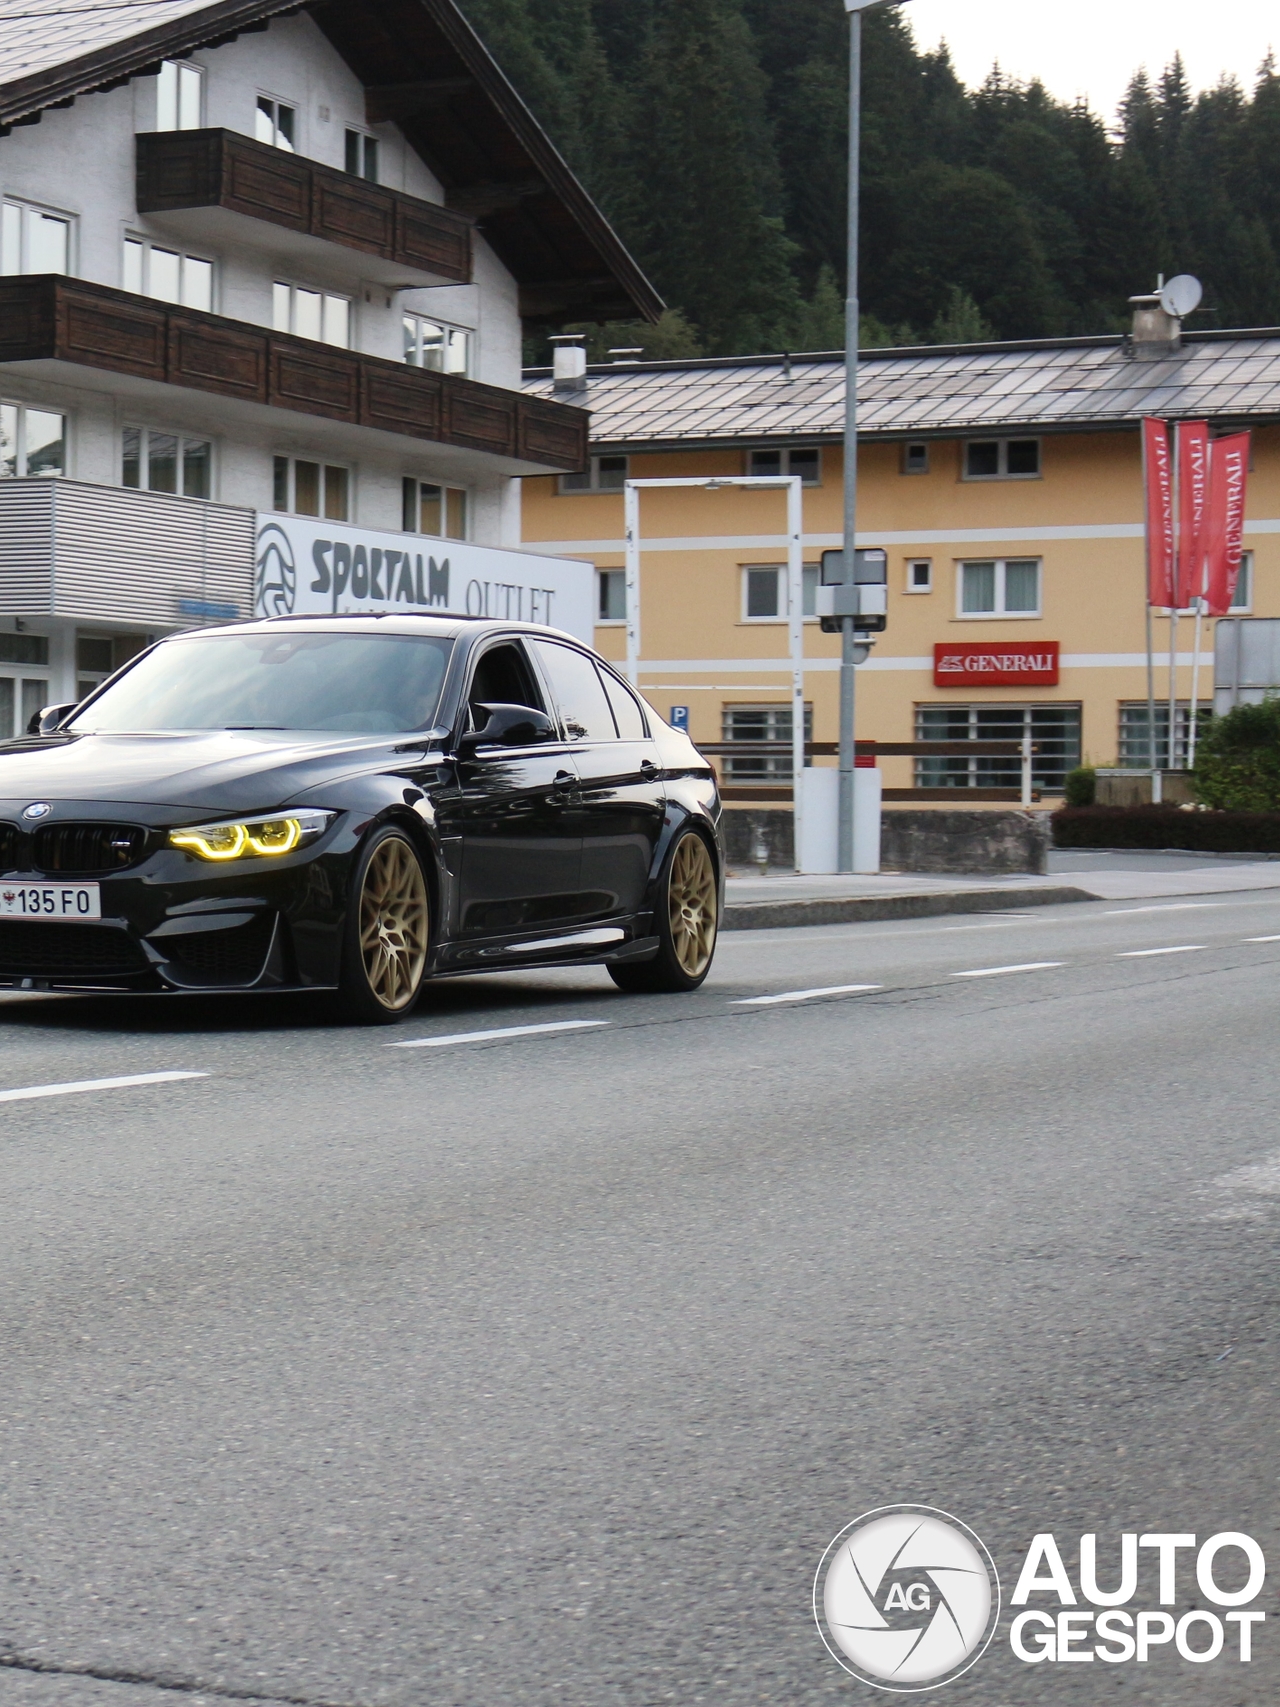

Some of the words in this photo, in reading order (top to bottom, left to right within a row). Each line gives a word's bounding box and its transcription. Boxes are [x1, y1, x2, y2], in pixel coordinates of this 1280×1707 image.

[1225, 451, 1243, 565] GENERALI
[964, 654, 1053, 672] GENERALI
[673, 707, 686, 722] P
[18, 889, 55, 913] 135
